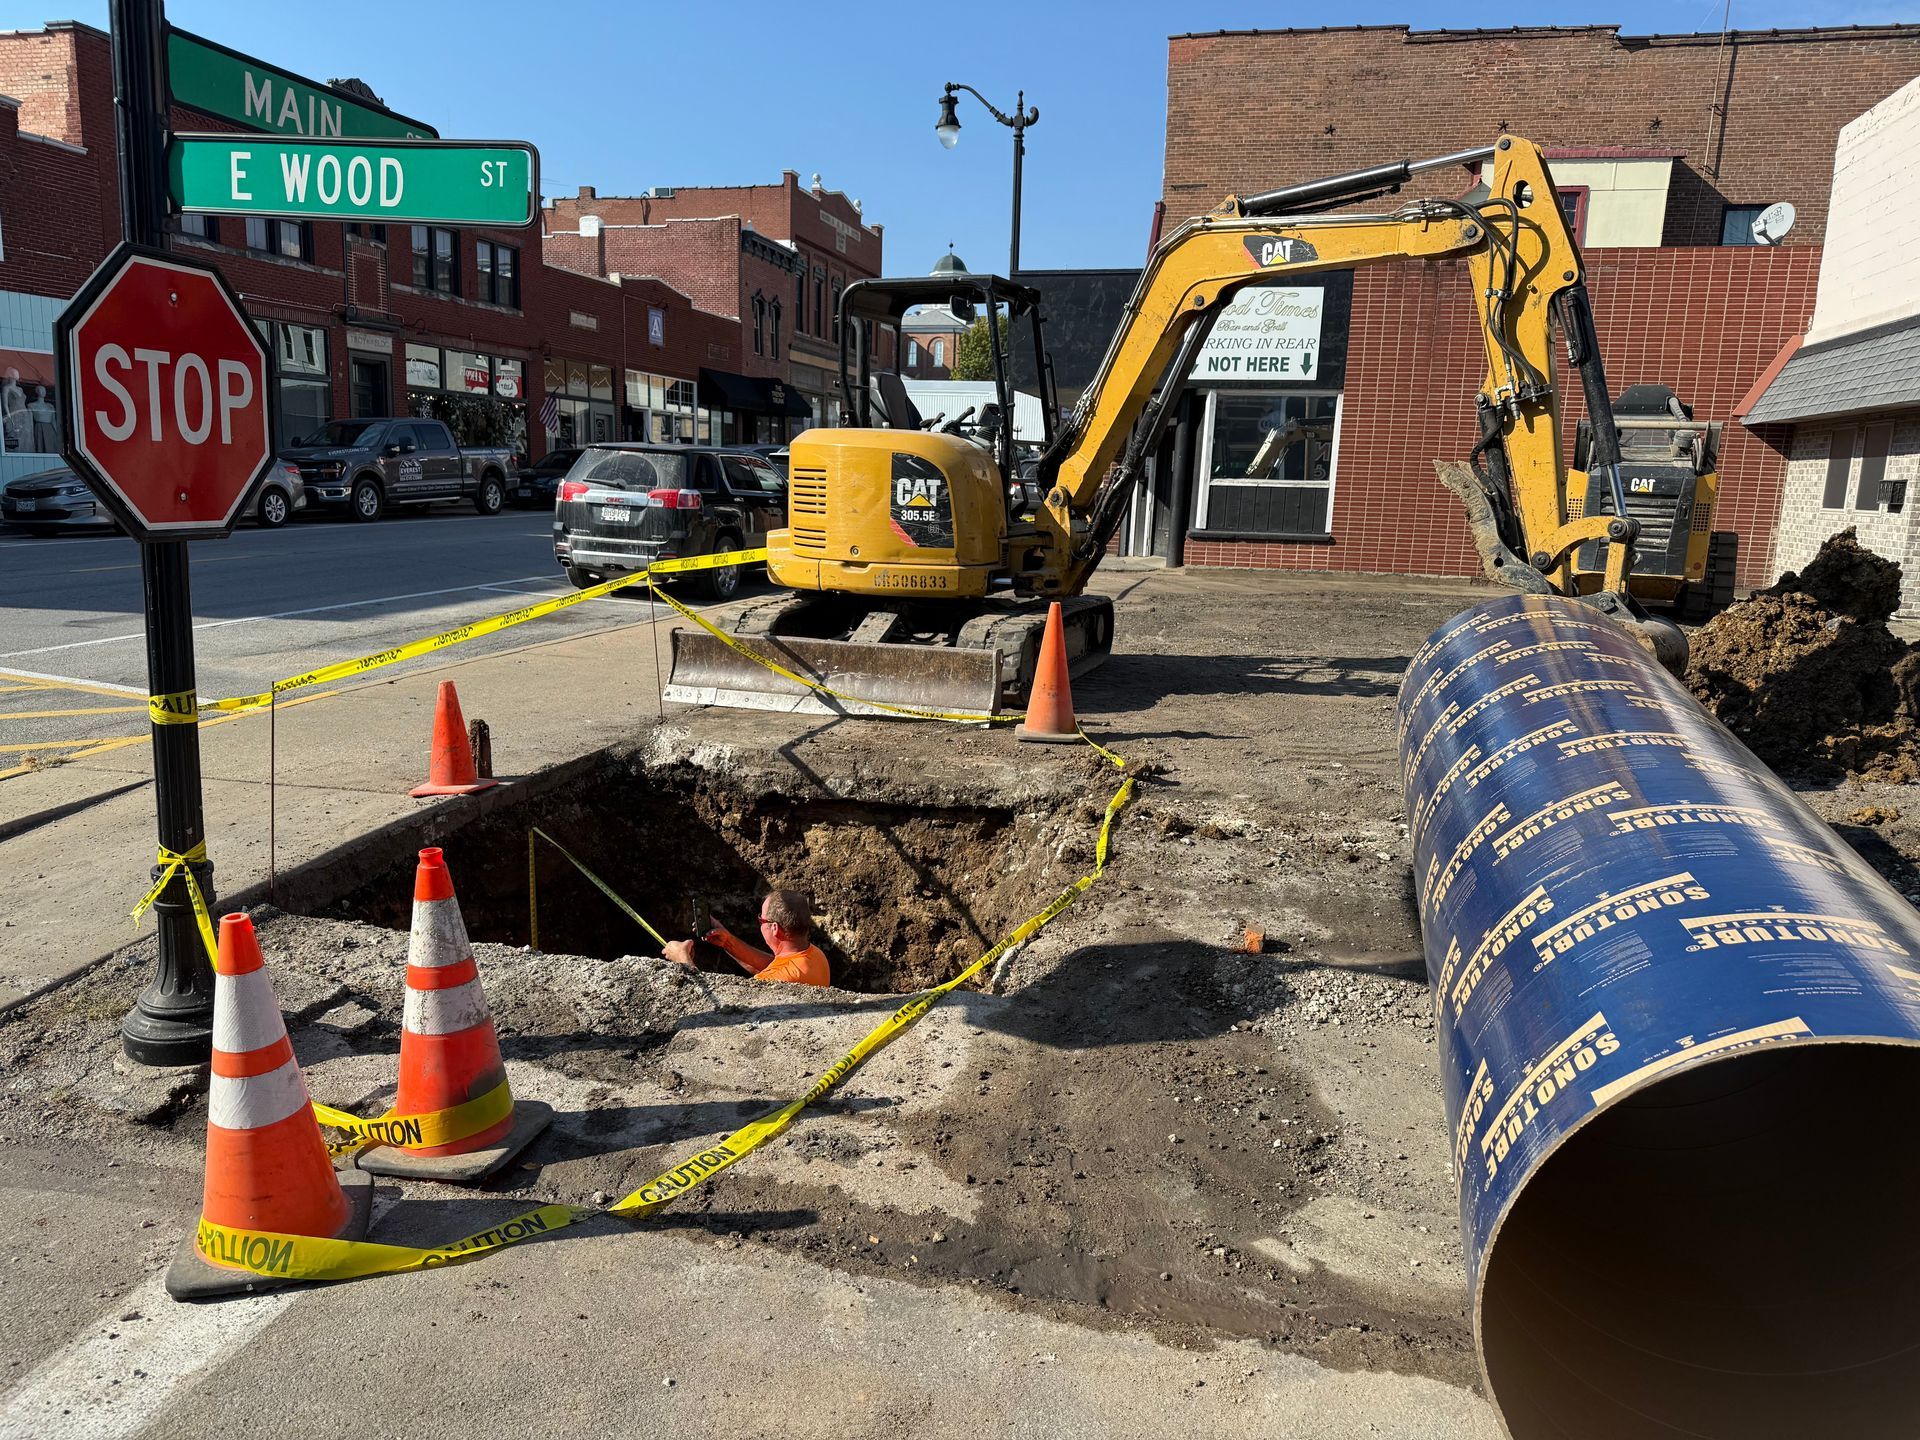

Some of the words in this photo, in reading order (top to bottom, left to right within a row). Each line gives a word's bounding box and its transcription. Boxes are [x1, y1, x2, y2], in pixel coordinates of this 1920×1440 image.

[245, 71, 342, 137] MAIN
[230, 151, 253, 201] E
[280, 153, 404, 207] WOOD
[481, 160, 508, 188] ST
[1262, 240, 1294, 266] CAT
[1216, 320, 1241, 332] Bar
[1242, 322, 1262, 332] and
[1261, 319, 1288, 334] Grill
[1255, 290, 1319, 318] Times
[1202, 338, 1253, 350] RKING
[1256, 338, 1272, 350] IN
[1276, 338, 1317, 350] REAR
[1207, 356, 1242, 373] NOT
[1246, 356, 1290, 373] HERE
[94, 343, 254, 445] STOP
[896, 478, 941, 507] CAT
[1630, 477, 1656, 493] CAT
[1446, 678, 1541, 736] SONOTUBE
[1469, 725, 1580, 789] SONOTUBE
[1497, 790, 1632, 859] SONOTUBE
[1615, 811, 1784, 834] SONOTUBE
[1433, 810, 1512, 912] SONOTUBE
[1539, 886, 1711, 966] SONOTUBE
[1546, 882, 1685, 946] commercial
[1692, 925, 1910, 956] SONOTUBE
[1454, 897, 1555, 1017] SONOTUBE
[1486, 1032, 1621, 1182] SONOTUBE
[1490, 1031, 1598, 1153] commercial
[349, 1117, 423, 1146] AUTION
[640, 1146, 738, 1203] CAUTION
